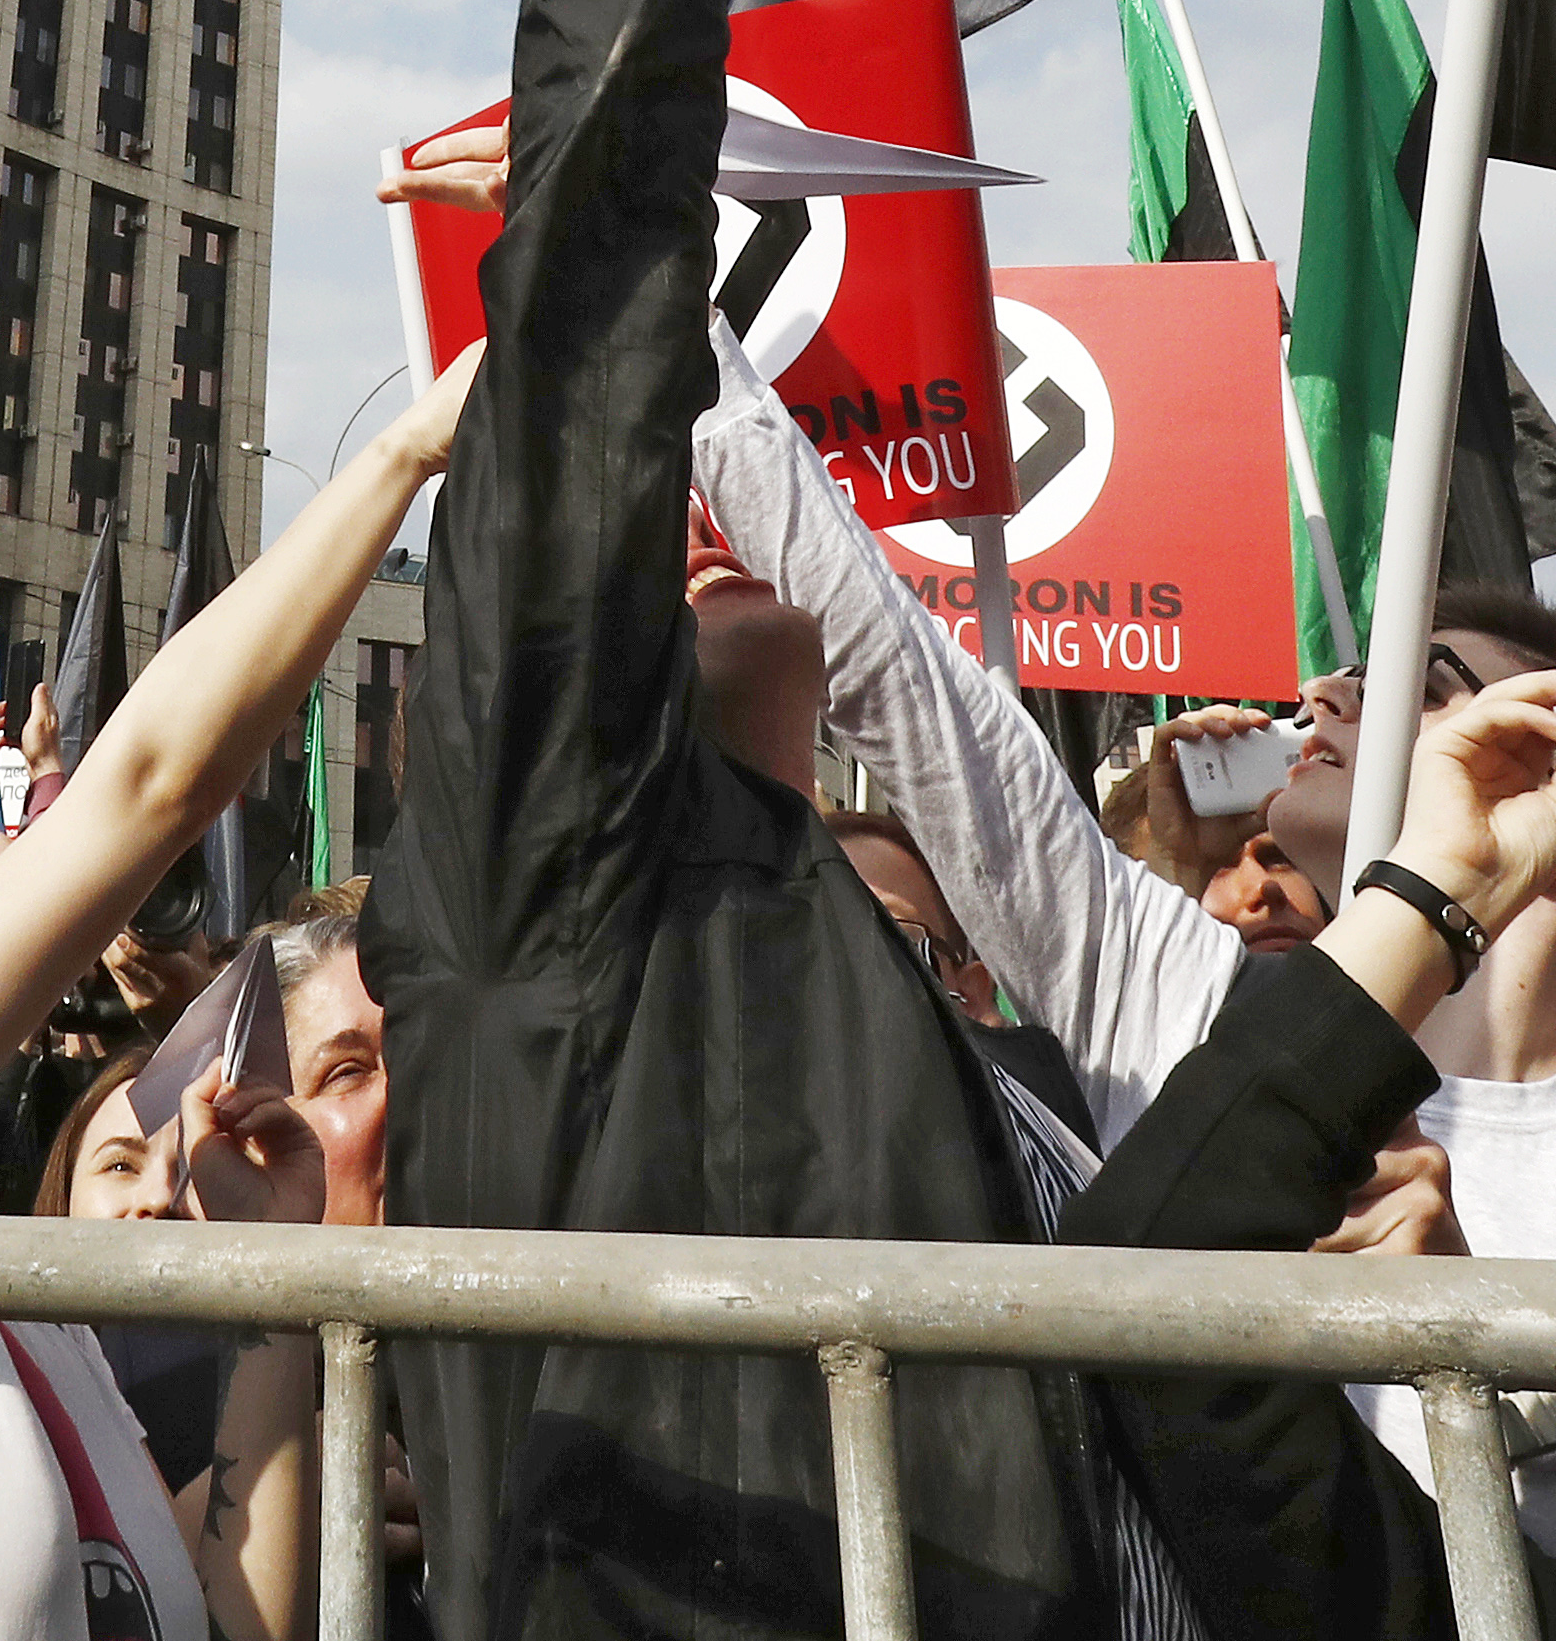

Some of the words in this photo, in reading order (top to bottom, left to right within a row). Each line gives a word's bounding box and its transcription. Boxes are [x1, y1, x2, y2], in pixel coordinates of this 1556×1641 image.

[900, 378, 968, 429] IS
[862, 431, 976, 500] YOU
[1129, 581, 1183, 620] IS
[1091, 622, 1182, 673] YOU
